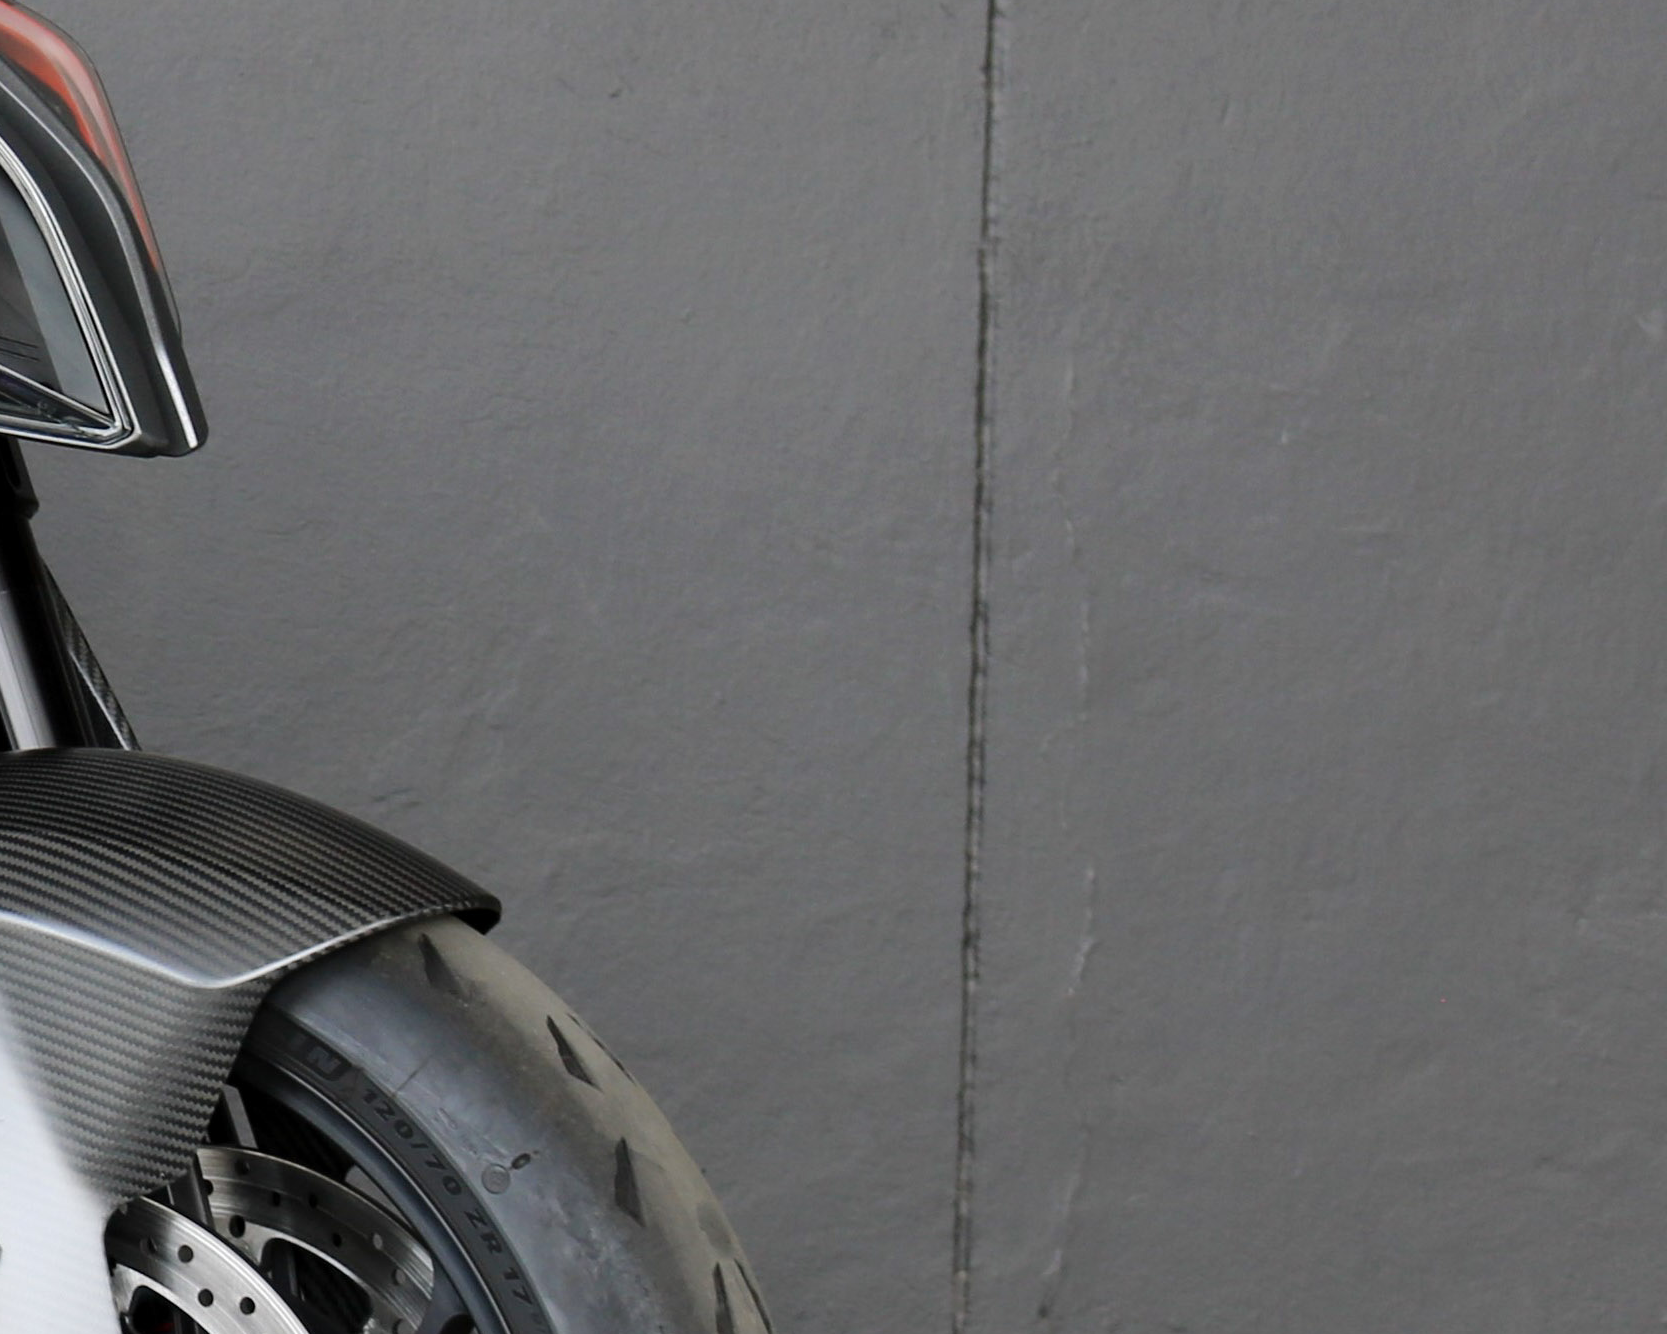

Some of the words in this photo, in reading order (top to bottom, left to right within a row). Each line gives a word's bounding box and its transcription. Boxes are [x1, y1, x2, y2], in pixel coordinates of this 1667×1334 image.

[359, 1087, 468, 1197] 120/70
[464, 1209, 505, 1255] ZR
[502, 1266, 535, 1308] 17
